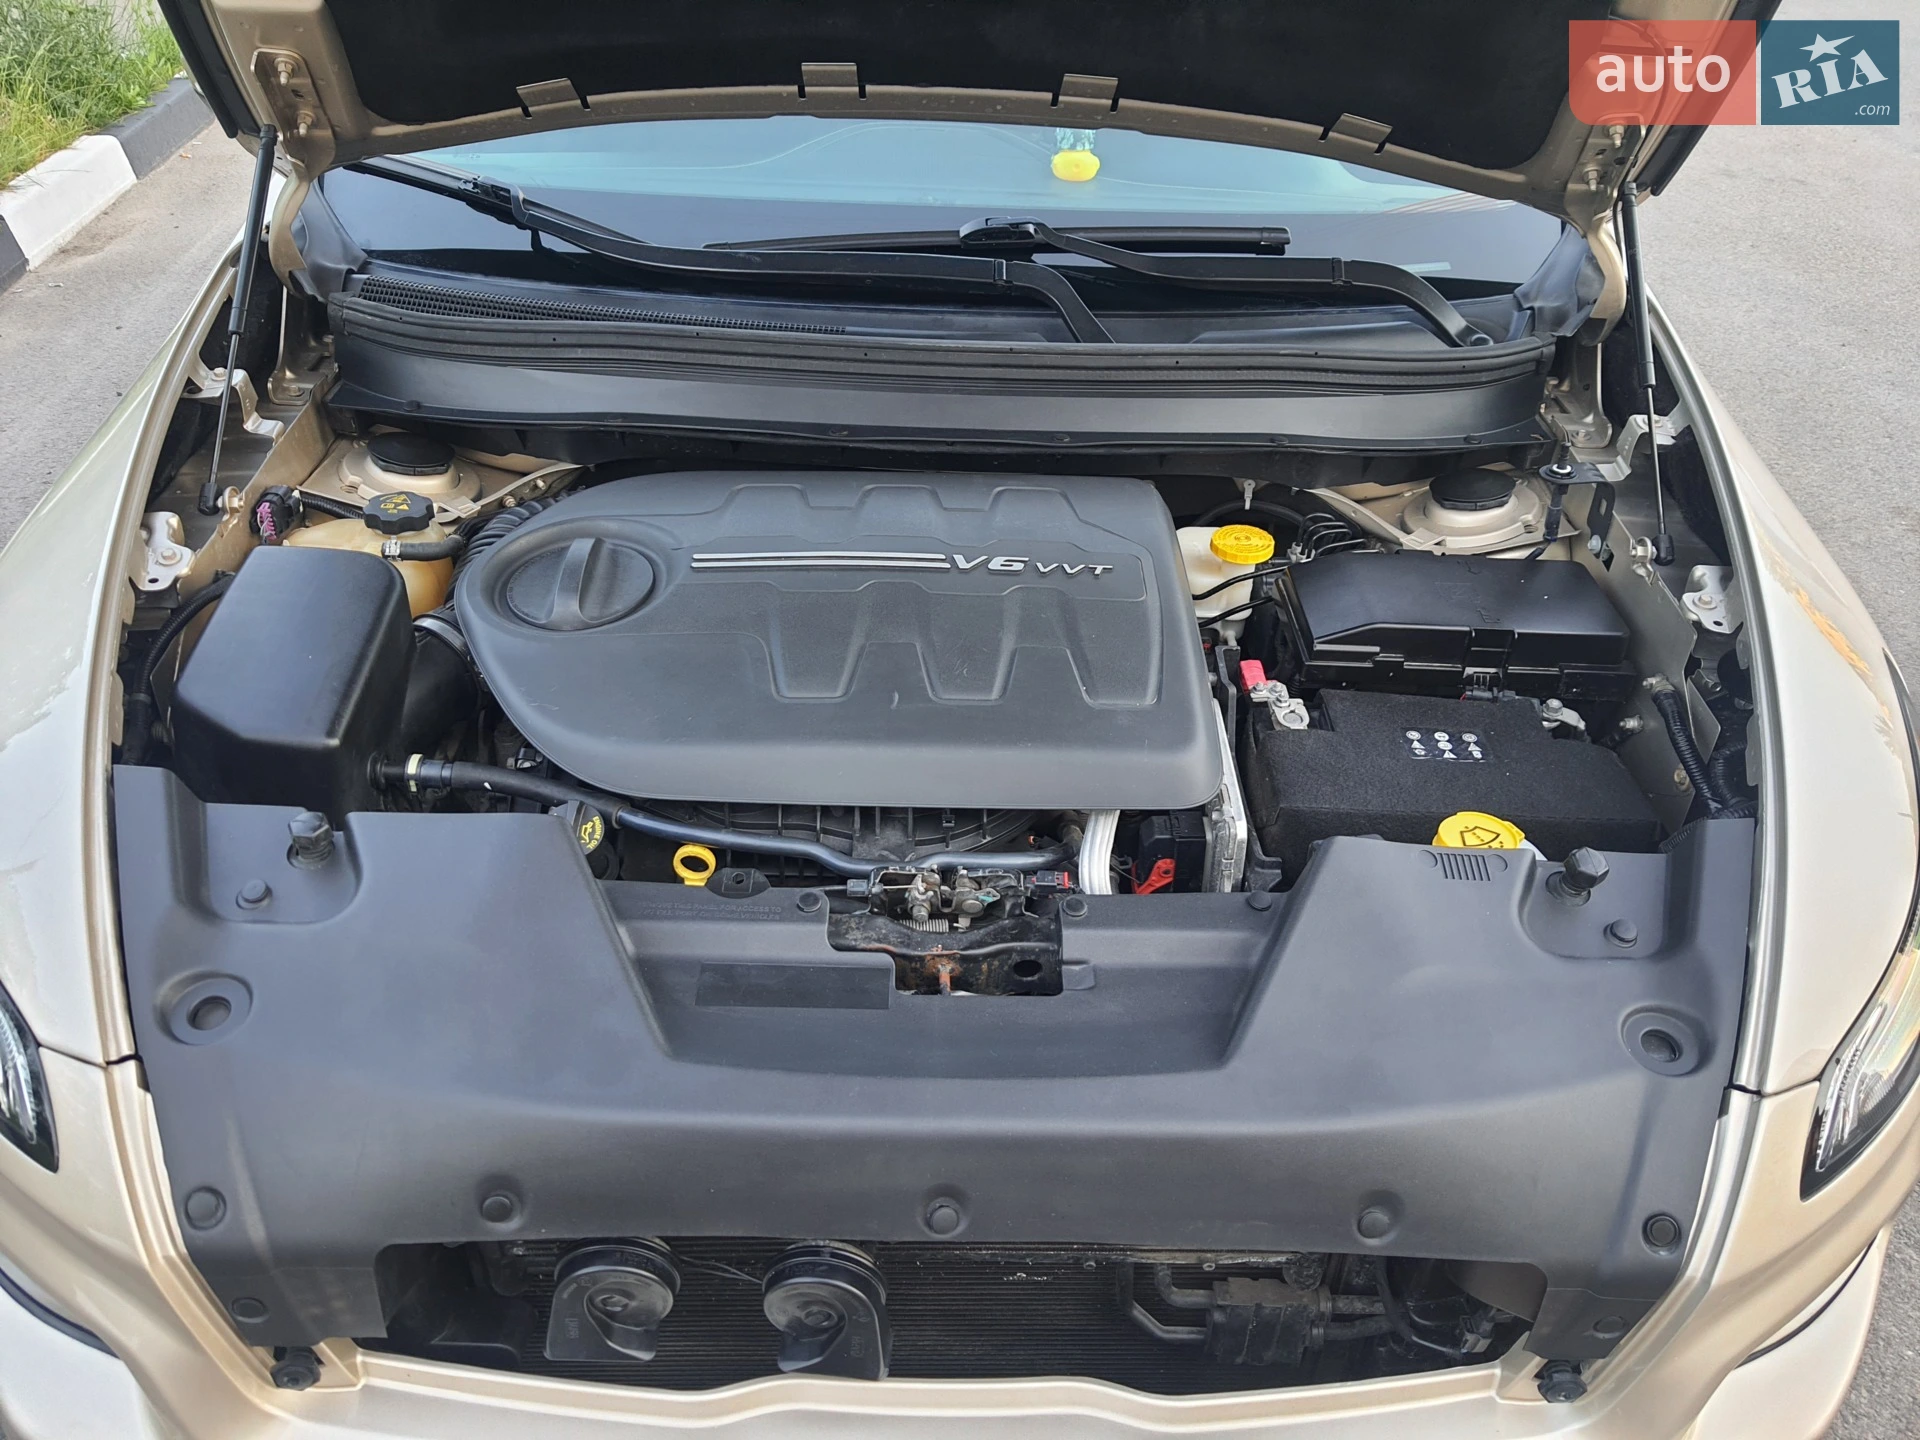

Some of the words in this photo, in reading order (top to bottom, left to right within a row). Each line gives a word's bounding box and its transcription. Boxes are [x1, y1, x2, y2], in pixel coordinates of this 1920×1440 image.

[952, 554, 1029, 573] V6
[1035, 562, 1114, 576] VVT
[592, 816, 602, 840] ENGINE
[586, 839, 598, 849] OIL
